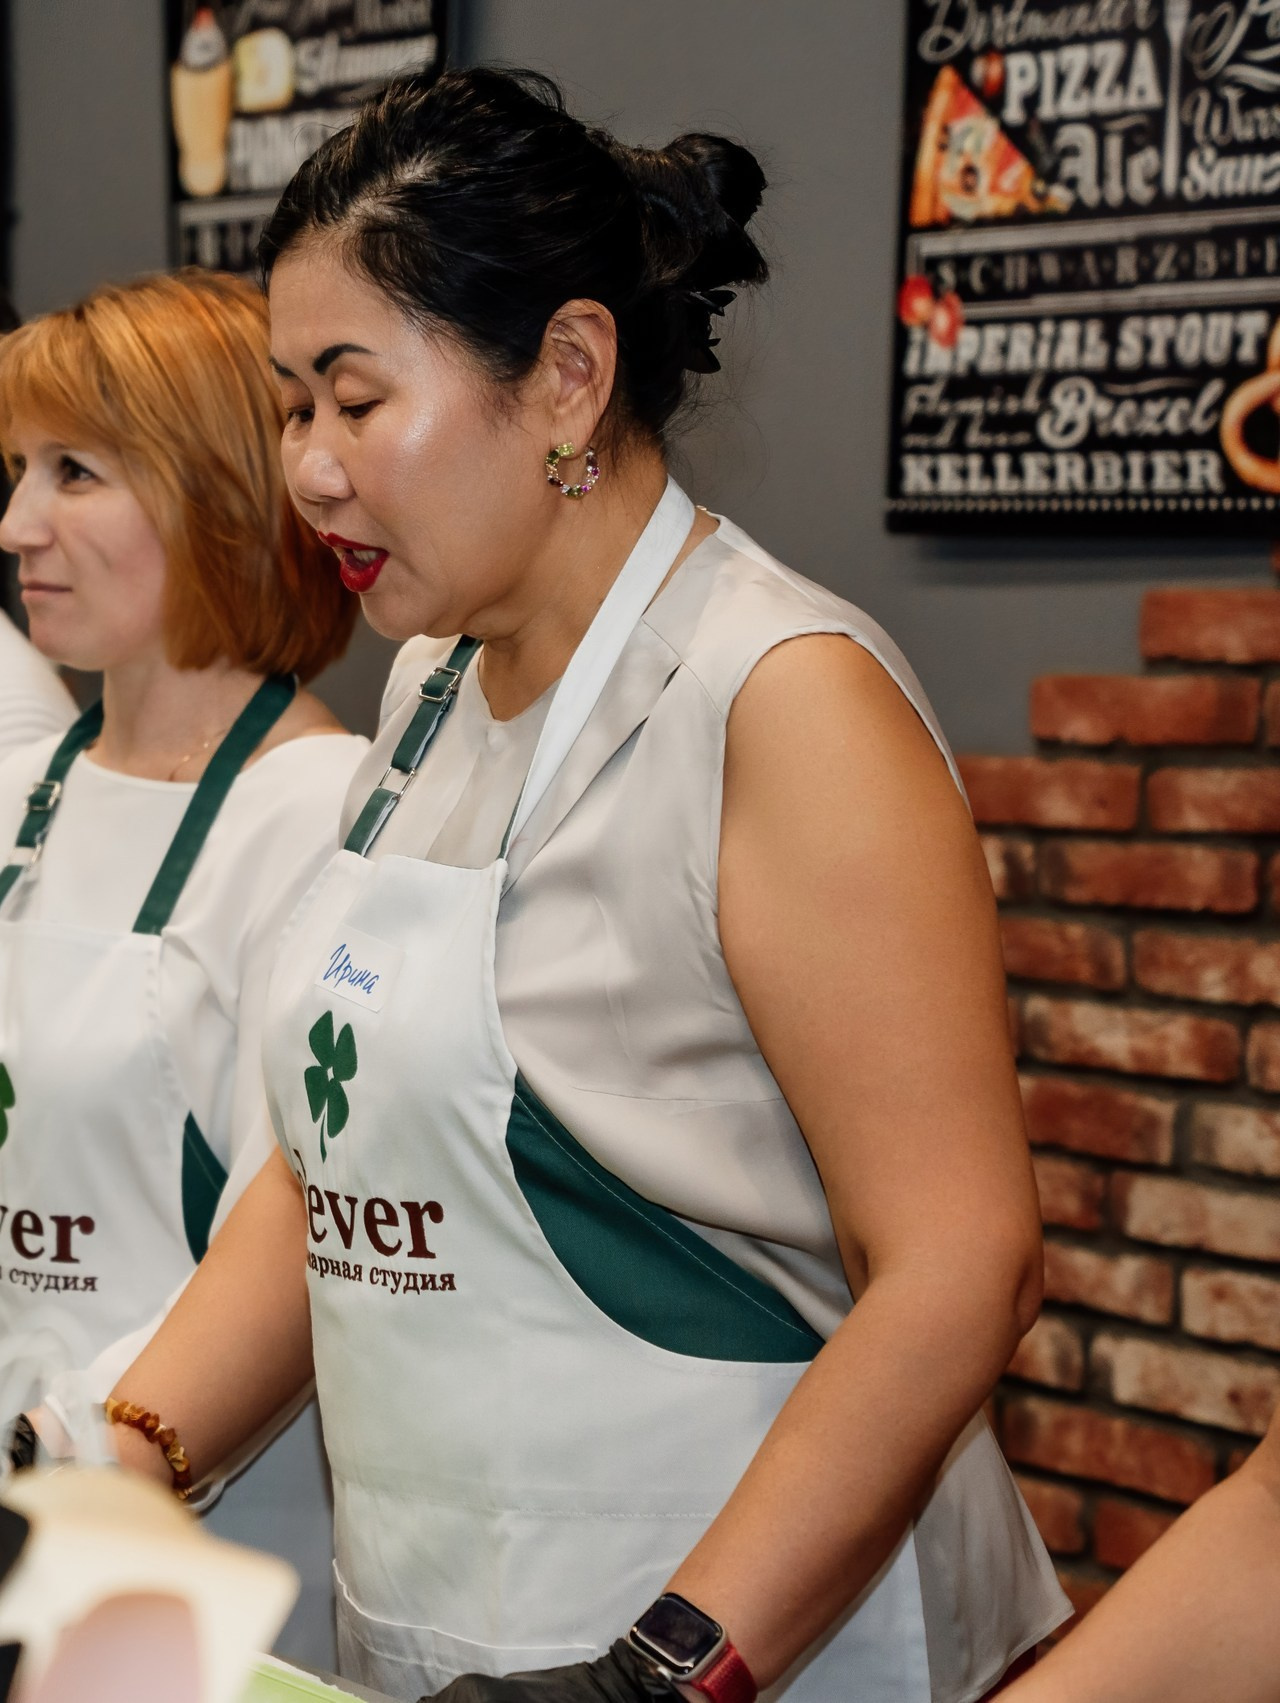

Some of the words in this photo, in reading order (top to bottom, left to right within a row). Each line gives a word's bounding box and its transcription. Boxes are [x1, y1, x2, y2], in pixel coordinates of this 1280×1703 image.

[1003, 38, 1163, 126] PIZZA
[1053, 122, 1161, 208] Ale
[1116, 310, 1271, 369] STOUT
[1036, 375, 1226, 449] Brezel
[900, 449, 1225, 495] KELLERBIER
[323, 943, 380, 995] Ирина
[8, 1267, 99, 1293] студия
[369, 1266, 457, 1295] студия
